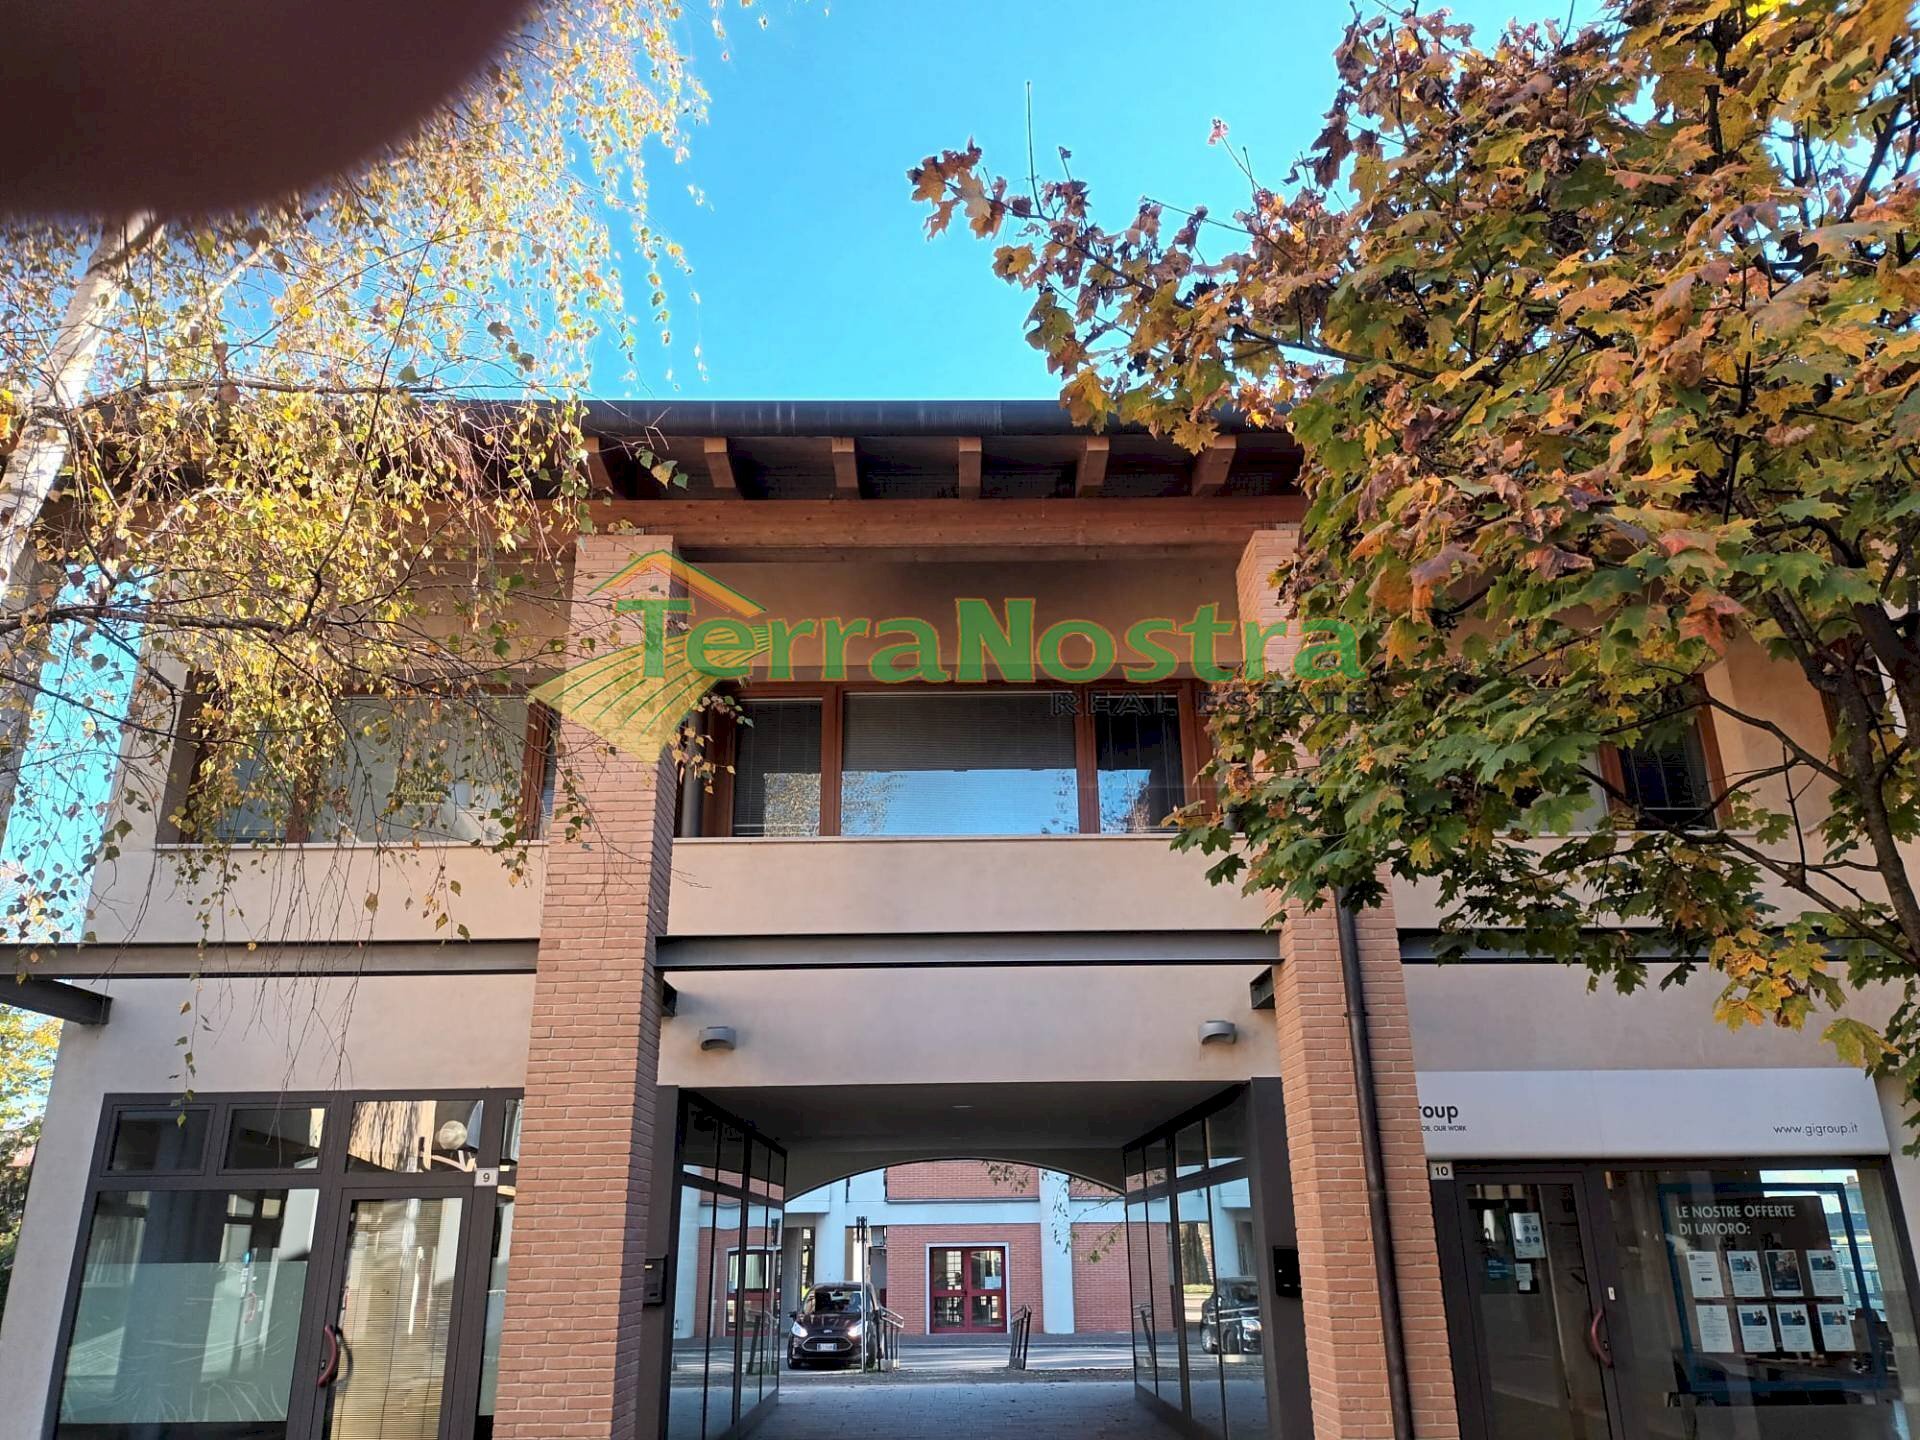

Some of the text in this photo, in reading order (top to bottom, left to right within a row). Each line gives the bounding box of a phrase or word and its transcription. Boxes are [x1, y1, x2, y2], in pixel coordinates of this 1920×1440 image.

[1773, 1122, 1858, 1137] www.gigroup.it
[483, 1172, 490, 1183] 9
[1435, 1166, 1449, 1176] 10
[1675, 1205, 1796, 1218] LE NOSTRE OFFERTE
[1679, 1222, 1752, 1235] DI LAVORO:
